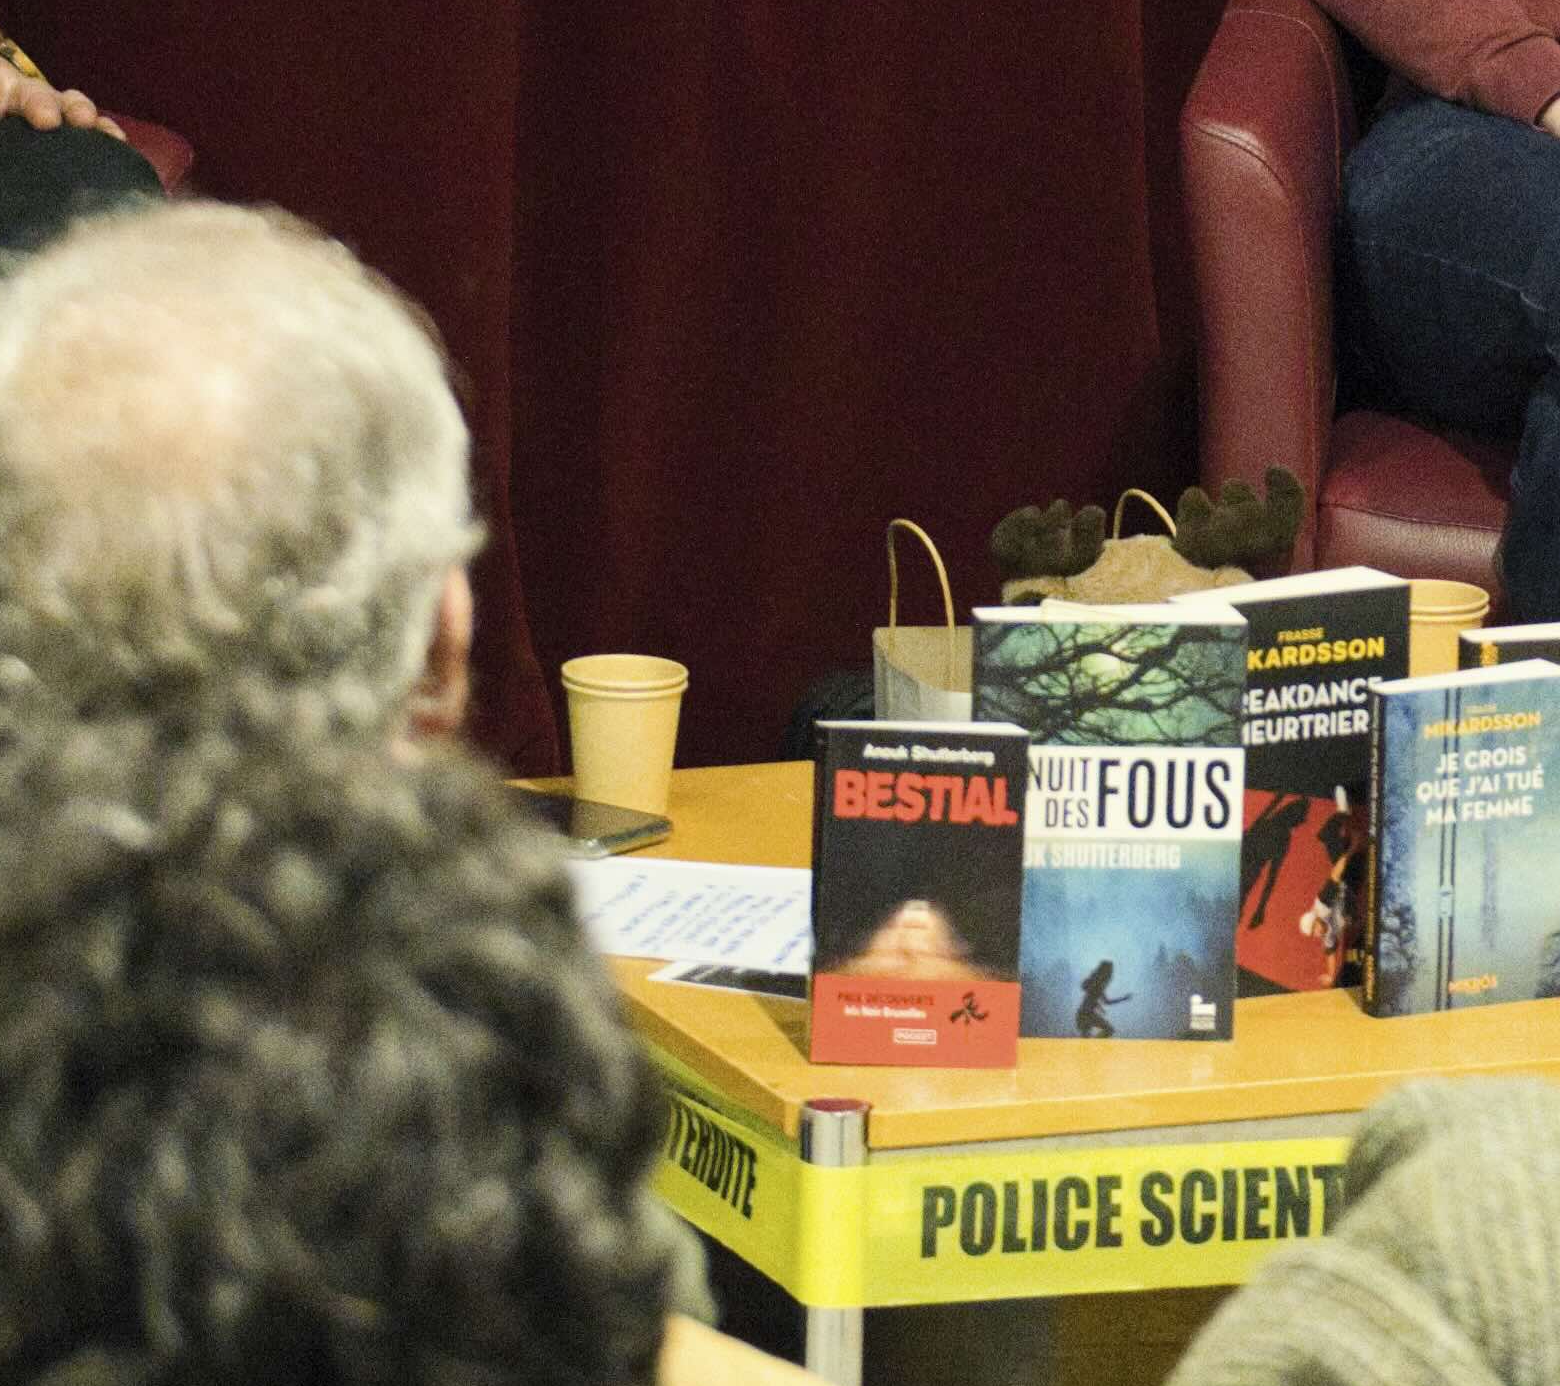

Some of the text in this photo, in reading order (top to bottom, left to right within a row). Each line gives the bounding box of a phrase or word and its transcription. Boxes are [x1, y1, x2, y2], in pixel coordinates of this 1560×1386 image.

[1435, 745, 1527, 775] JE CROIS
[833, 768, 1020, 827] BESTIAL
[1097, 759, 1232, 829] FOUS
[1416, 778, 1461, 805] QUE
[1504, 763, 1544, 791] TUÉ
[1045, 798, 1090, 829] DES
[1425, 795, 1534, 827] MA FEMME
[1051, 844, 1182, 870] SHUTTERBERG
[921, 1174, 1123, 1259] POLICE
